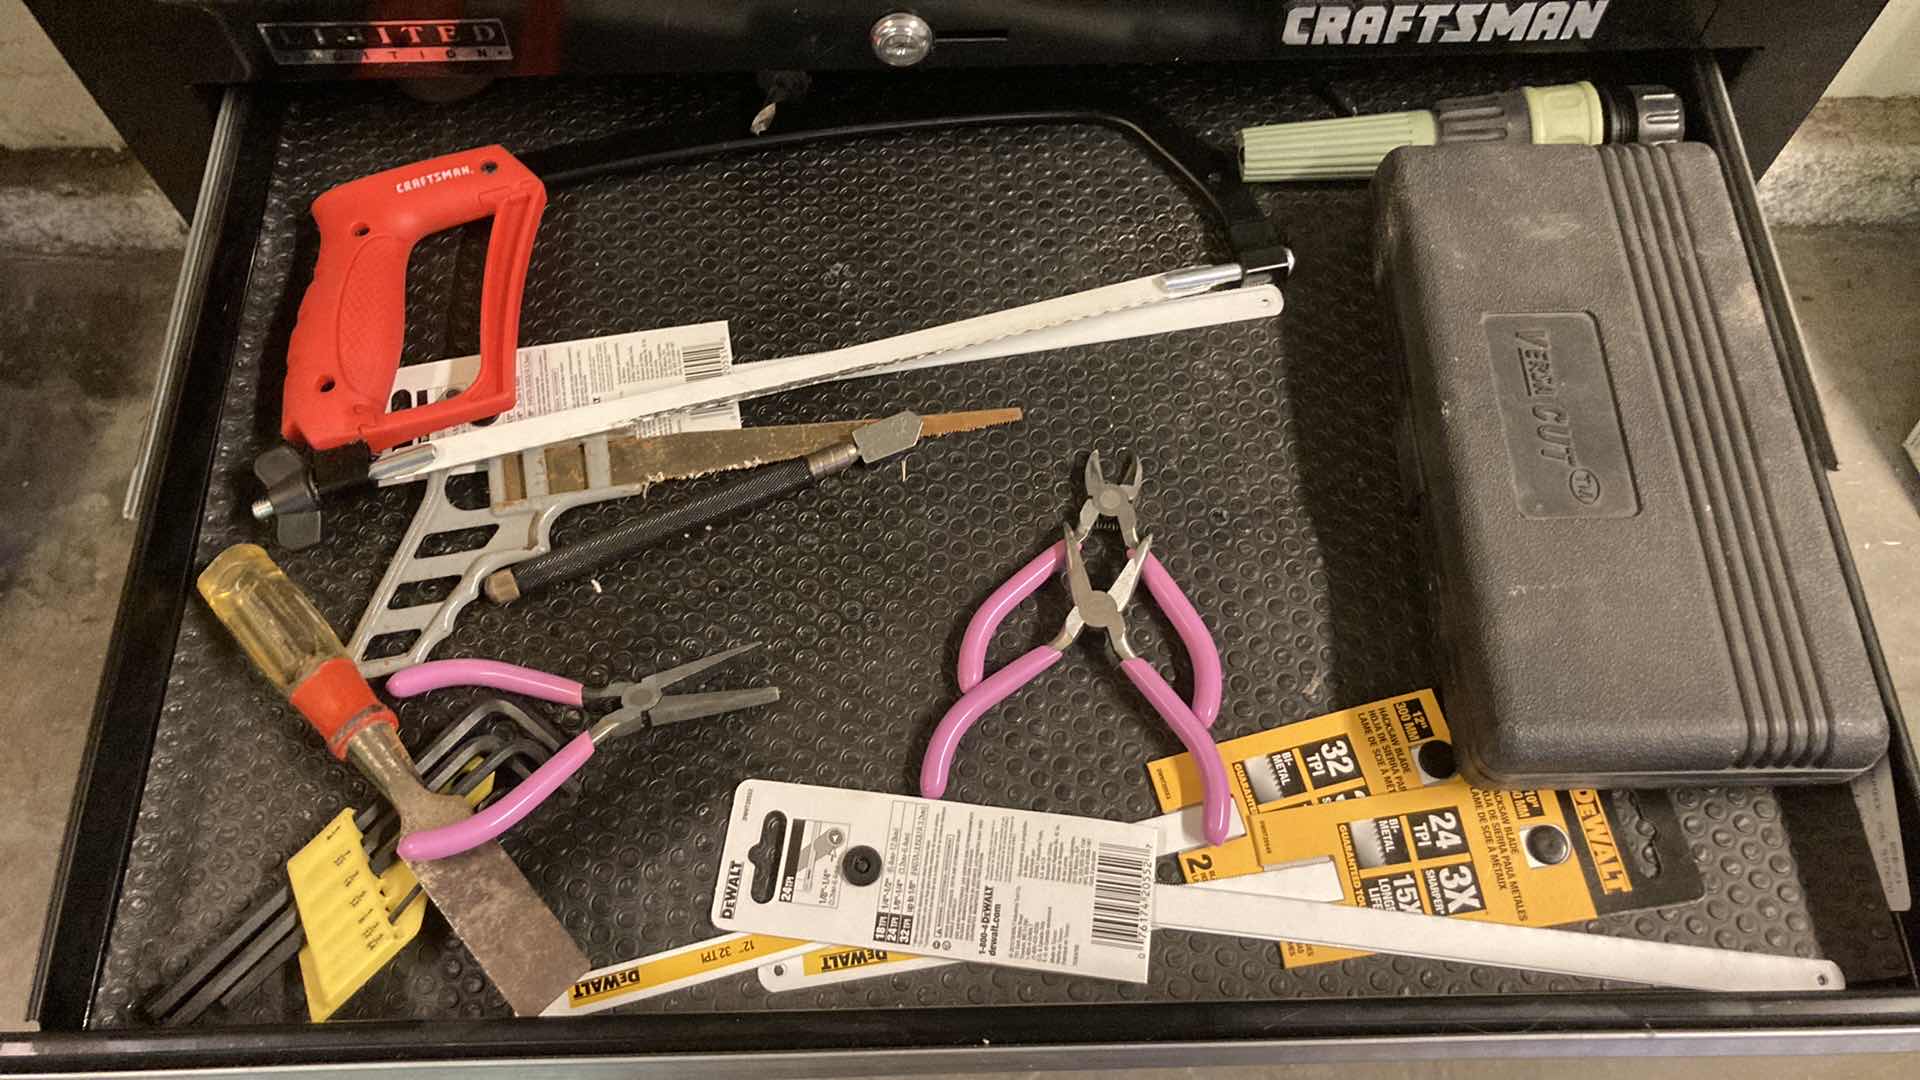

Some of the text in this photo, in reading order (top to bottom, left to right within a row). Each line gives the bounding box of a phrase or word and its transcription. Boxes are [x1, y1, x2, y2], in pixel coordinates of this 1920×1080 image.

[1281, 2, 1608, 45] CRAFTSMAN
[396, 165, 470, 193] CRAFTSMAN
[1531, 402, 1576, 467] CUT
[1357, 712, 1372, 734] LAME
[1394, 701, 1421, 741] 300 MM
[1366, 736, 1377, 748] DE
[1367, 709, 1407, 792] HOJA DE SIERRA PAR
[1378, 706, 1411, 774] HACKSAW BLADE
[1272, 753, 1291, 785] METAL
[1304, 752, 1325, 776] TPI
[1318, 738, 1355, 777] 32
[1371, 748, 1386, 767] SCIE
[1233, 762, 1258, 814] GUARANTE
[1477, 811, 1487, 822] DE
[1492, 789, 1519, 854] ACKSAW BLADE
[1514, 799, 1529, 817] MM
[1377, 819, 1395, 852] METAL
[1412, 822, 1431, 847] TPI
[1427, 810, 1462, 849] 24
[1481, 824, 1493, 844] SCIE
[1574, 790, 1631, 892] DEWALT
[1186, 853, 1213, 875] 2
[1338, 824, 1362, 888] GUARANTEED
[1354, 888, 1367, 908] TOU
[1482, 790, 1528, 921] OJA DE SIERRA PARA METALES
[1489, 853, 1508, 890] MÉTAUX
[1140, 860, 1152, 896] 20552
[1377, 878, 1396, 911] LONGE
[1437, 862, 1481, 914] 3X
[986, 903, 1001, 956] dewalt.com
[700, 949, 717, 963] TPI
[717, 945, 732, 958] 32
[571, 967, 641, 998] DEWALT
